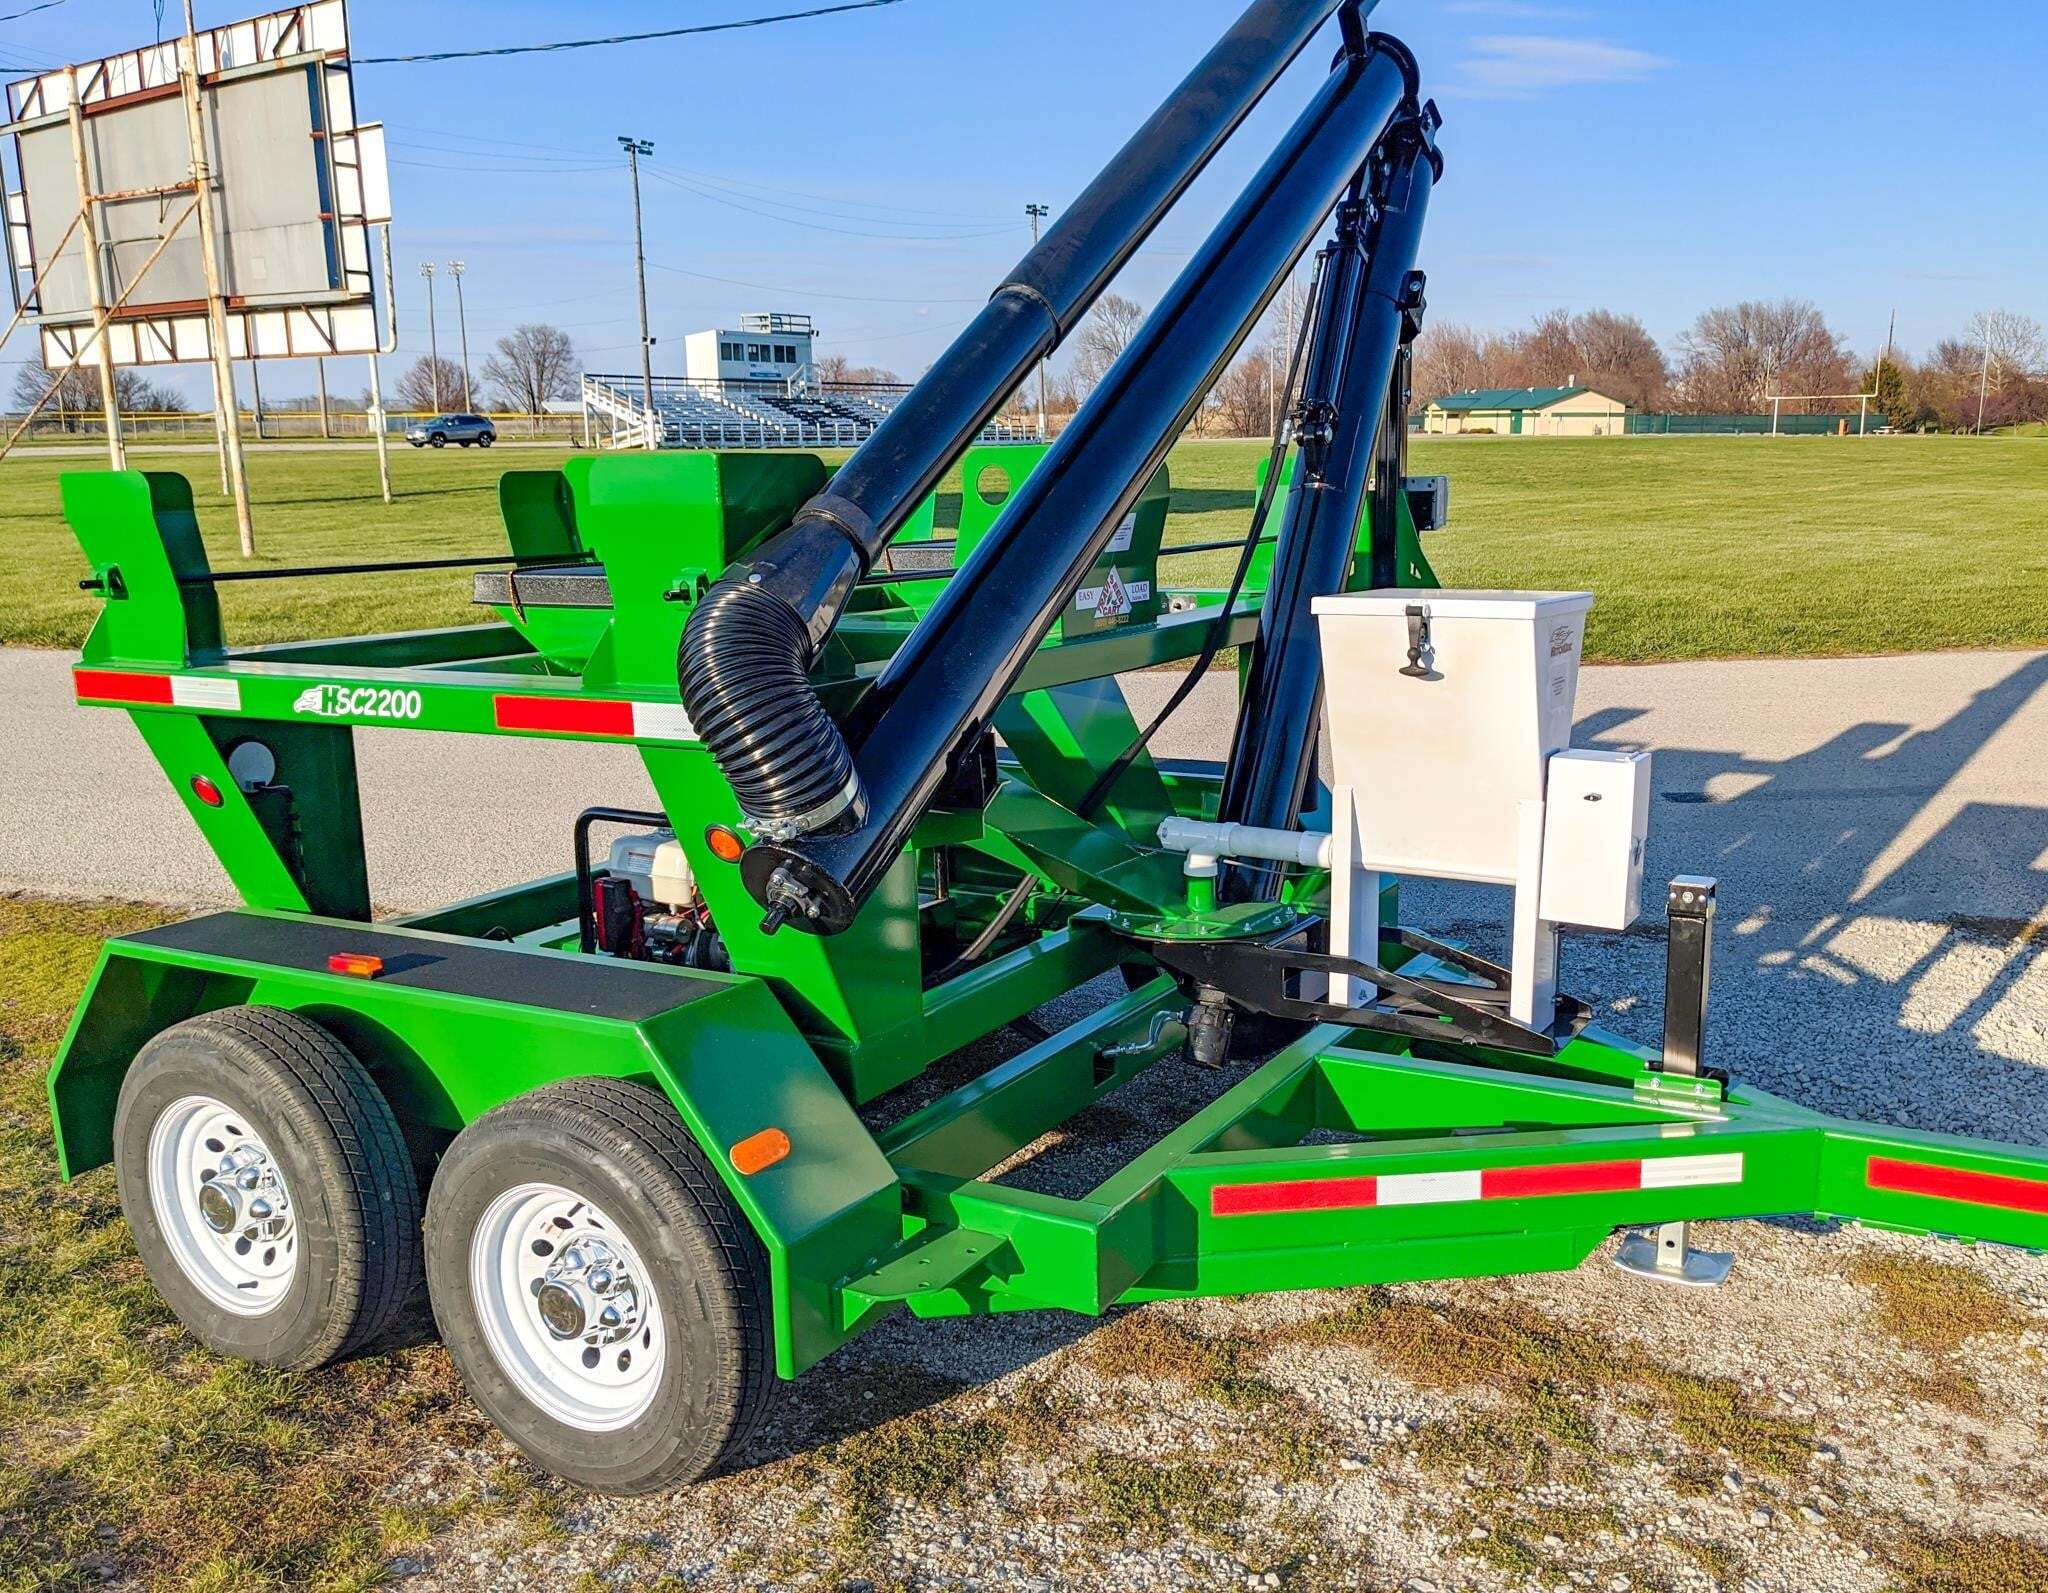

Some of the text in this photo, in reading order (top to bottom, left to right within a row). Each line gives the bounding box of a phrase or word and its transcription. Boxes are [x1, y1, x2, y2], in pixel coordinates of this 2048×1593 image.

[1131, 583, 1147, 594] LOAD
[1078, 590, 1095, 601] EASY
[1102, 604, 1121, 616] CART
